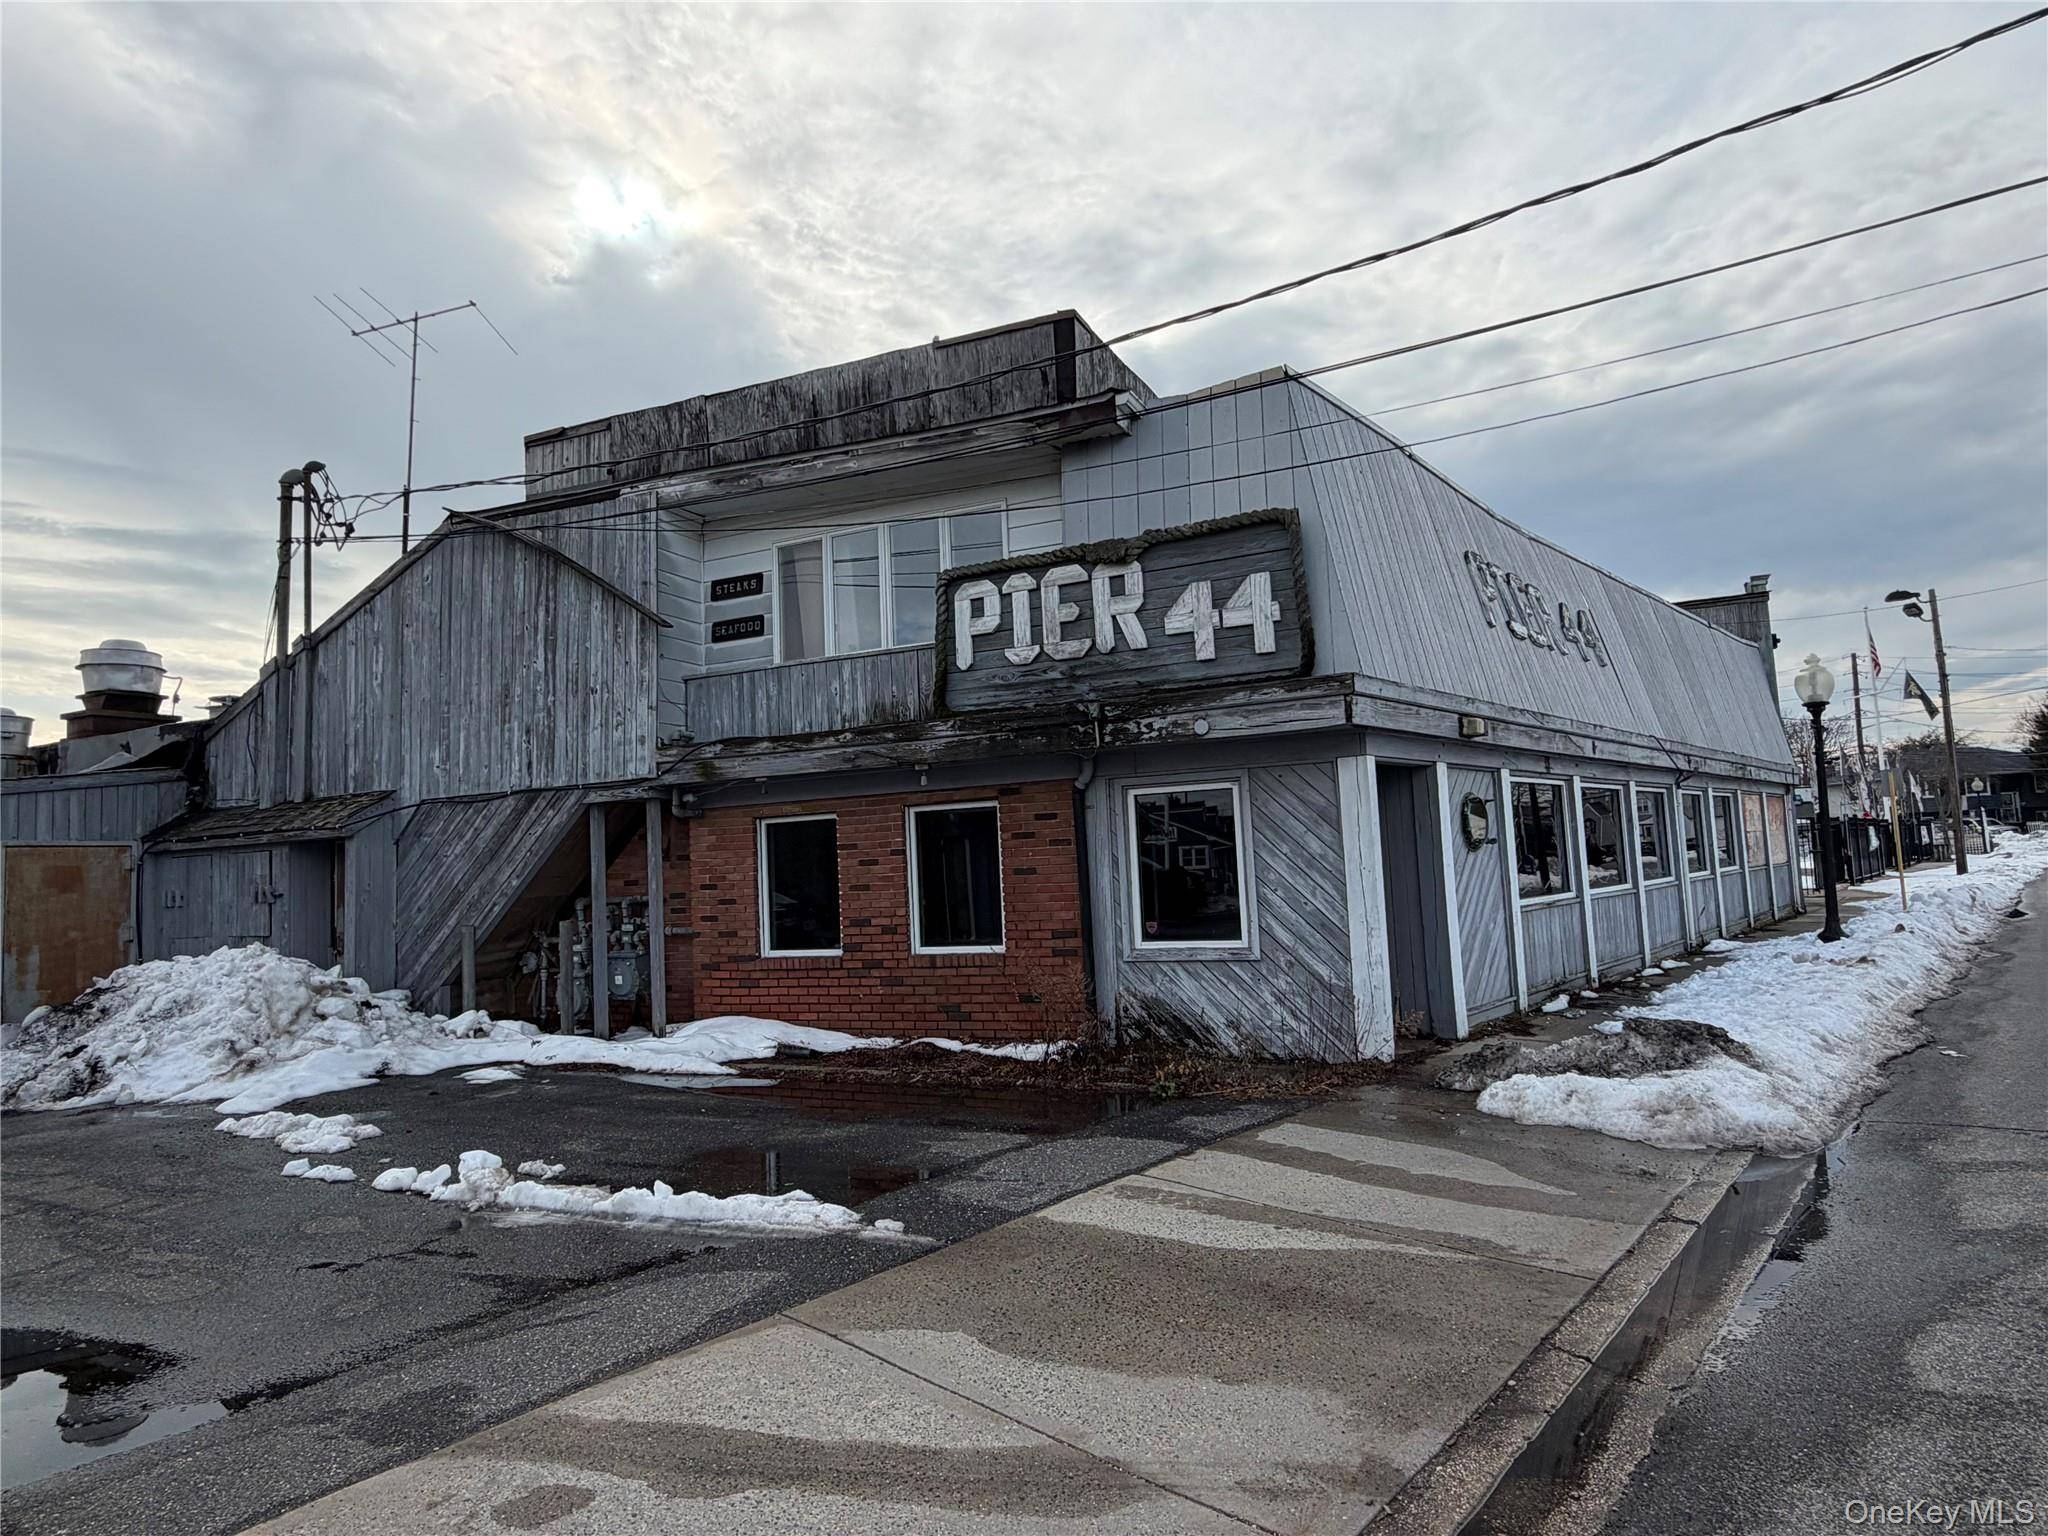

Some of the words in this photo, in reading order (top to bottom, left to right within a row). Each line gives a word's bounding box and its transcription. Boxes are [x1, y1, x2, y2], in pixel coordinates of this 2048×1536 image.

[715, 579, 757, 595] STEAKS
[954, 560, 1148, 670] PIER
[1164, 571, 1280, 661] 44
[715, 620, 761, 636] SEAFOOD
